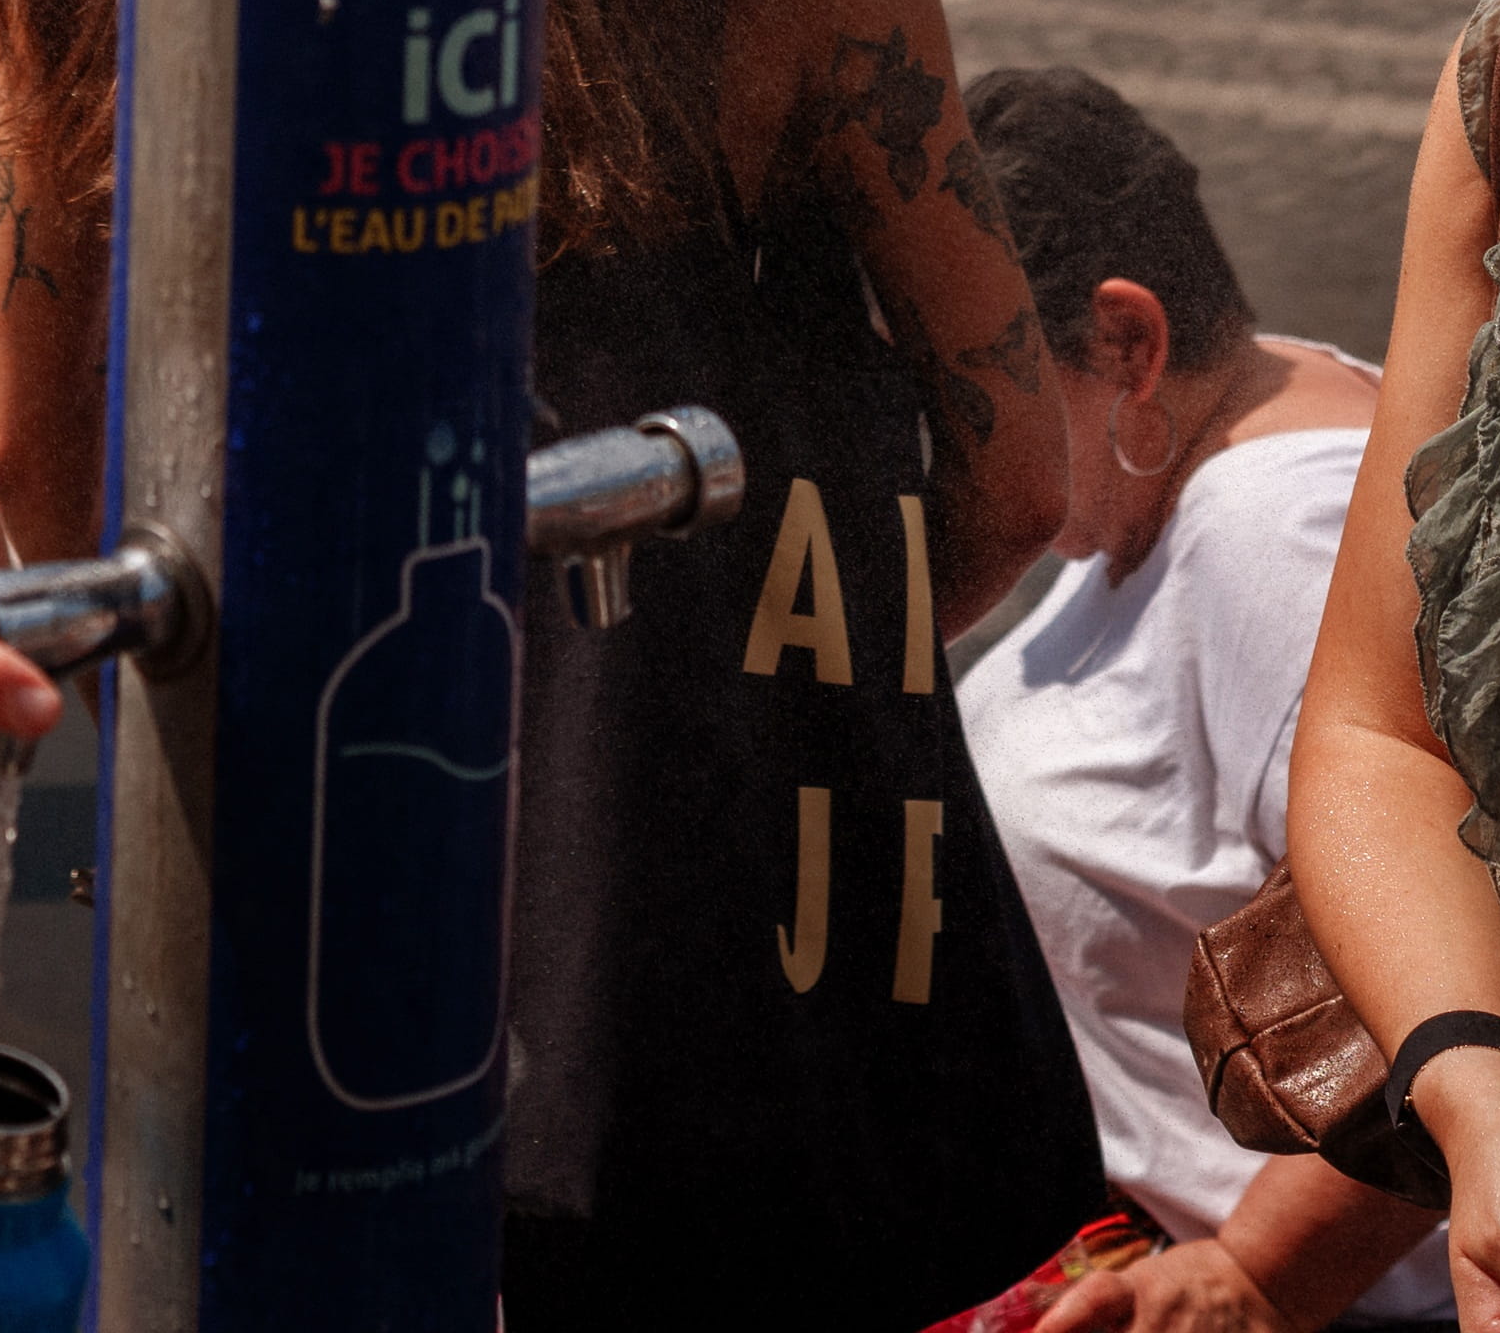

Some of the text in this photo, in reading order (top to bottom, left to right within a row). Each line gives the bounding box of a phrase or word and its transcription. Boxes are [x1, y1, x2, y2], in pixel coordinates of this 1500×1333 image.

[317, 139, 383, 198] JE
[291, 201, 427, 255] L'EAU
[434, 195, 487, 250] DE
